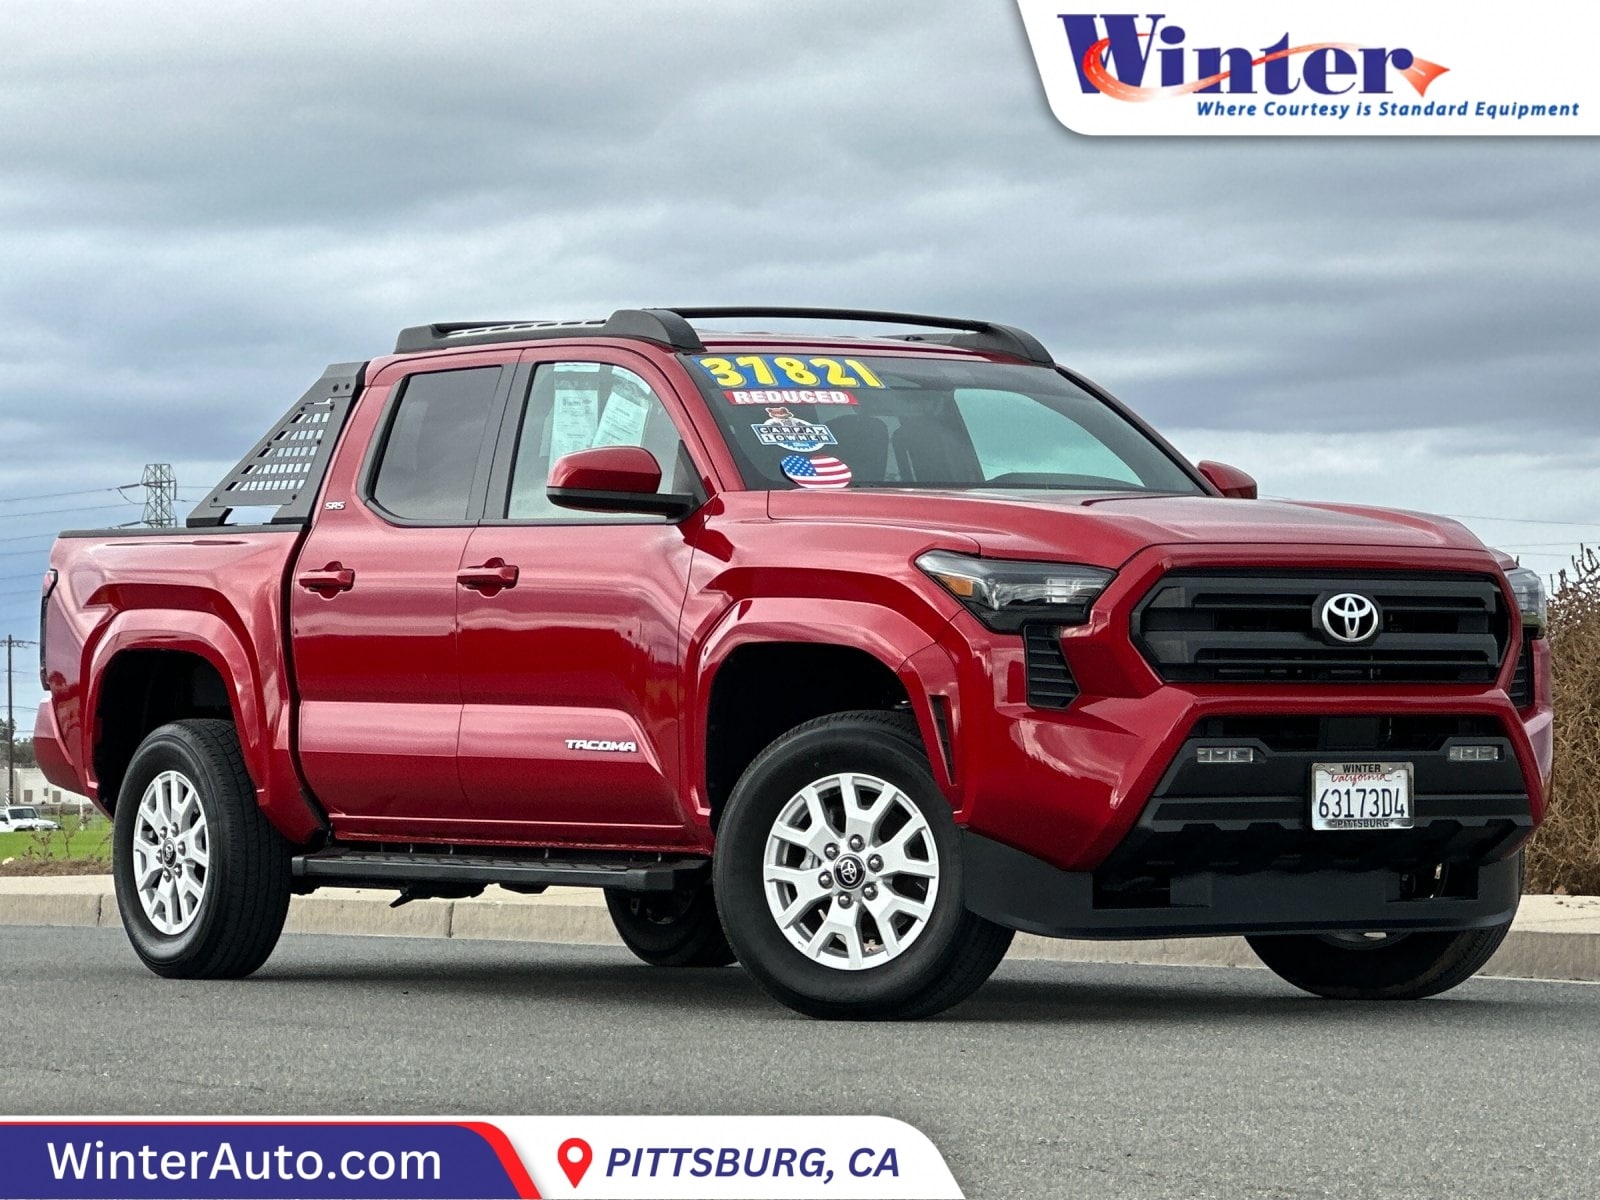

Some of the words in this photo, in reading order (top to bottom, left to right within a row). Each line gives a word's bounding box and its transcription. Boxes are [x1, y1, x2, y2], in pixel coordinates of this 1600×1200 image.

[699, 356, 885, 387] 37821
[732, 390, 850, 405] REDUCED
[565, 739, 637, 753] TACOMA
[1342, 763, 1381, 773] WINTER
[1330, 773, 1392, 787] California
[1318, 787, 1406, 818] 63173D4
[1337, 819, 1390, 829] PITTSBURG
